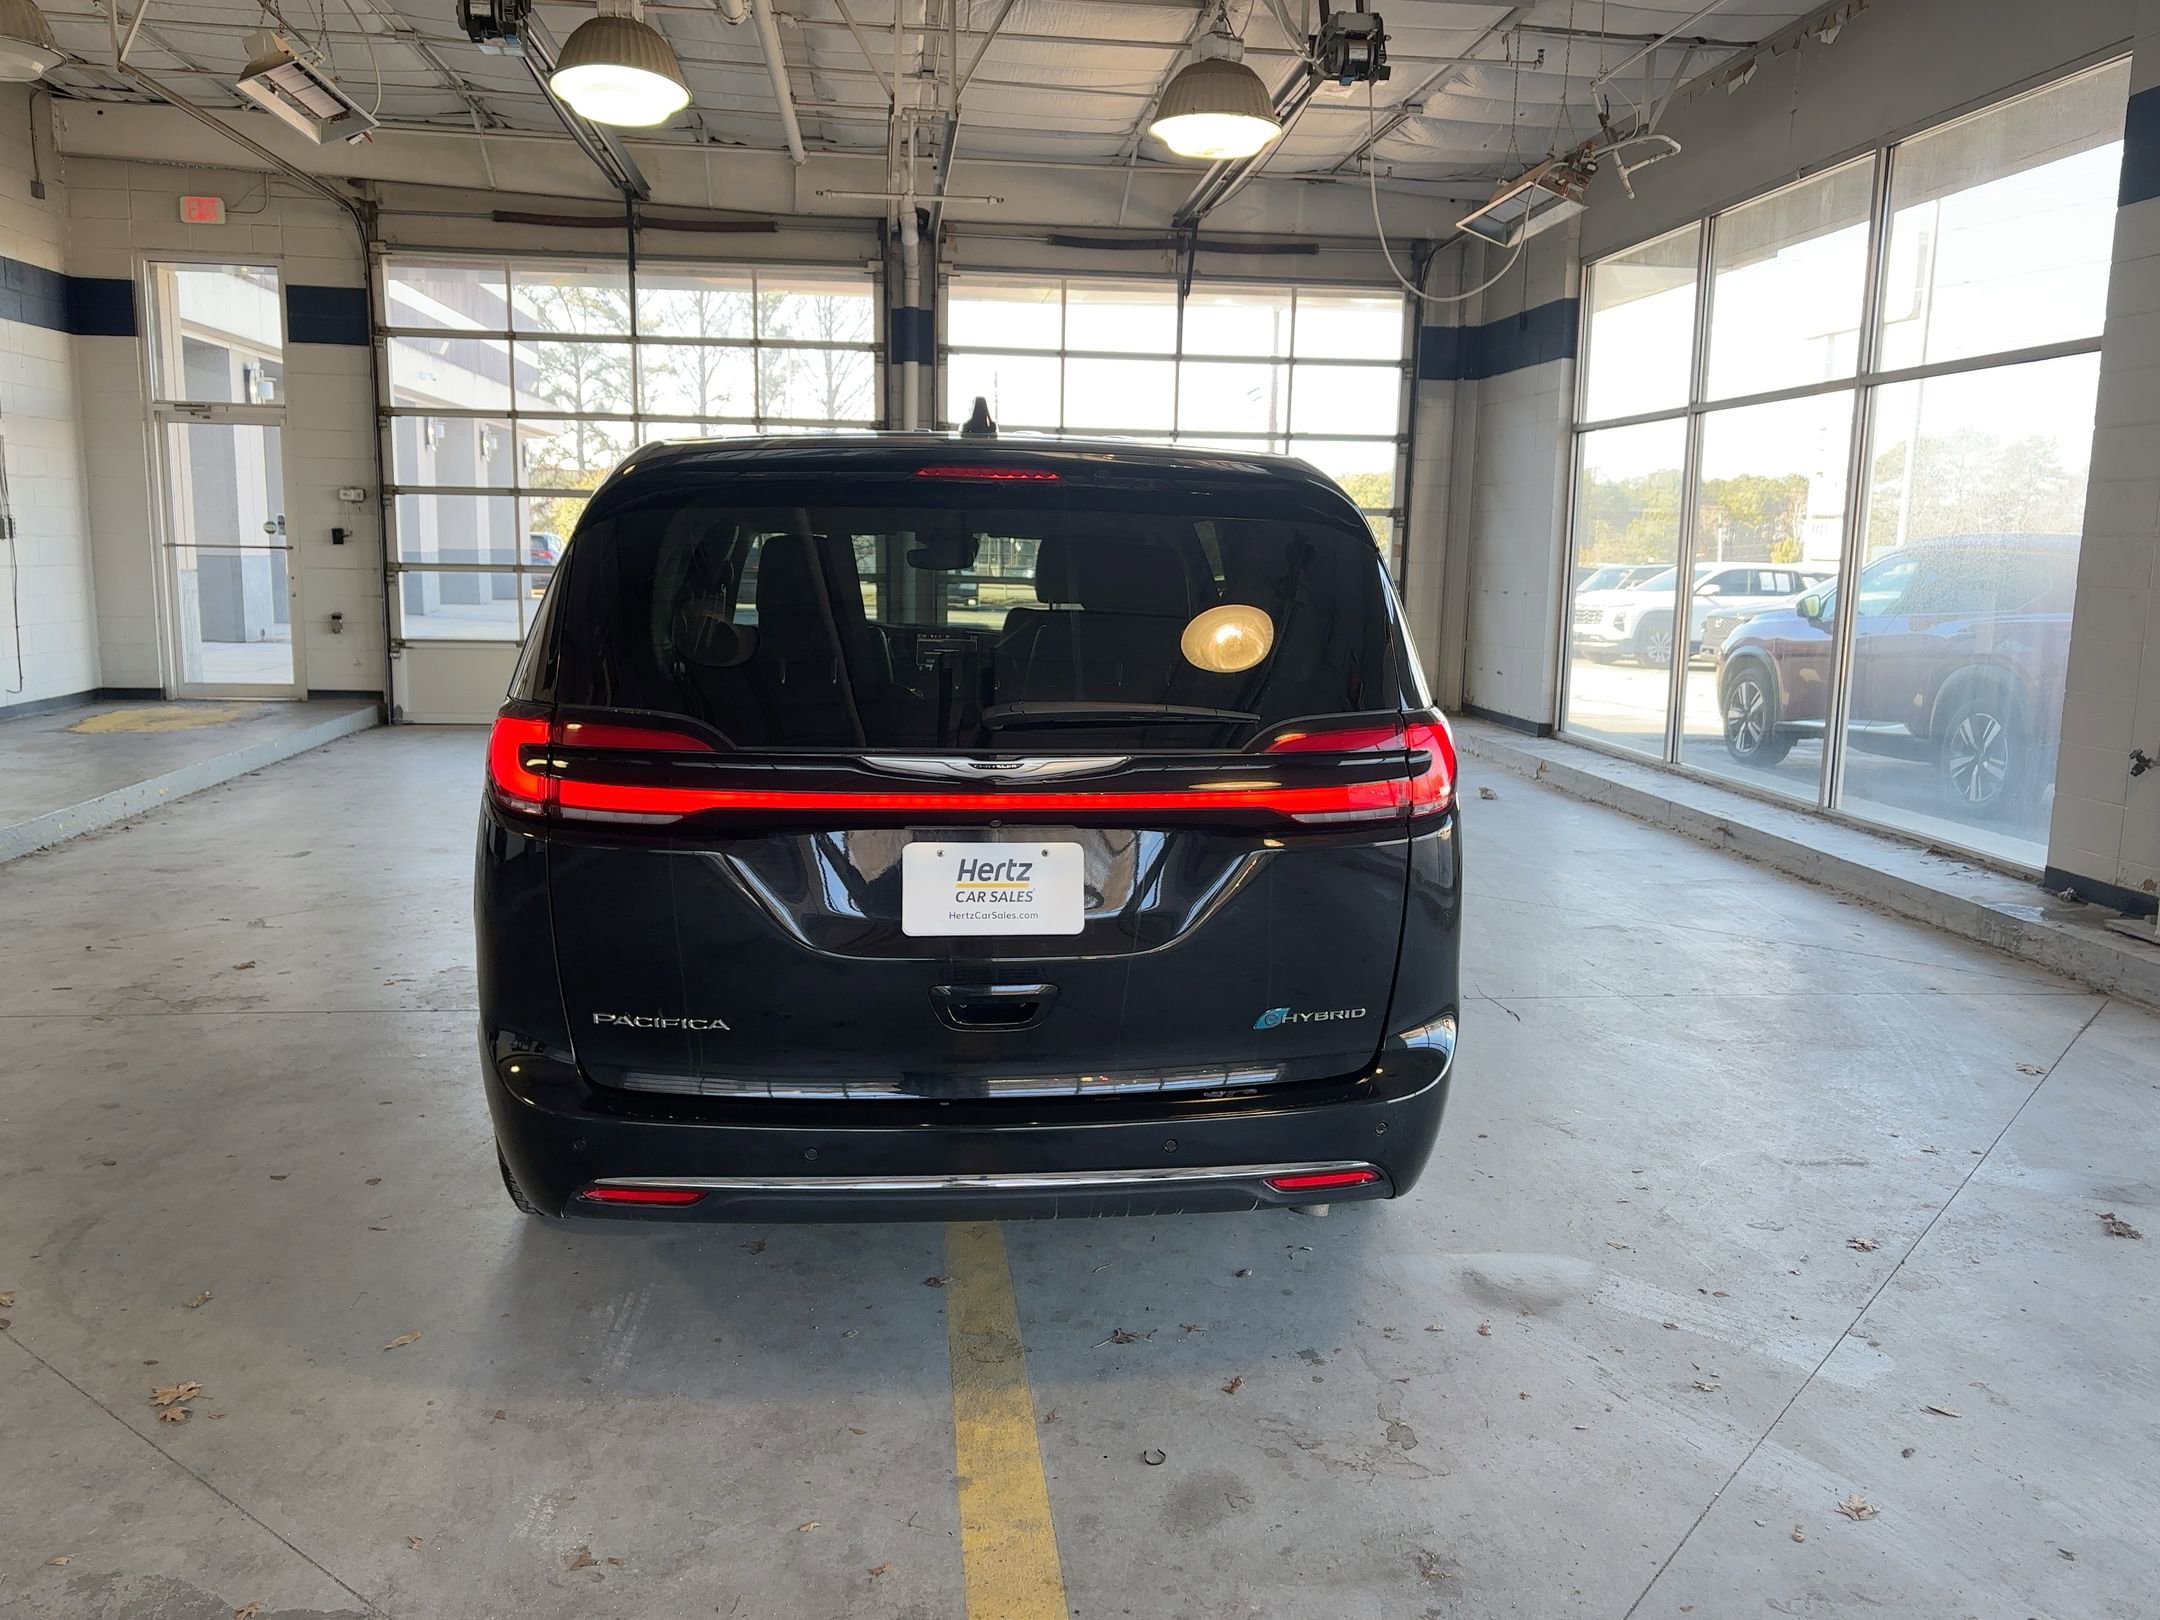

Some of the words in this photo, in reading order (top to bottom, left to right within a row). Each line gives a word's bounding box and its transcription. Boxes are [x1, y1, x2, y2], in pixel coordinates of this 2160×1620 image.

[957, 858, 1033, 882] Hertz
[955, 890, 986, 903] CAR
[989, 890, 1033, 903] SALES
[949, 911, 1039, 920] HertzCarSales.com
[592, 1012, 731, 1031] PACIFICA
